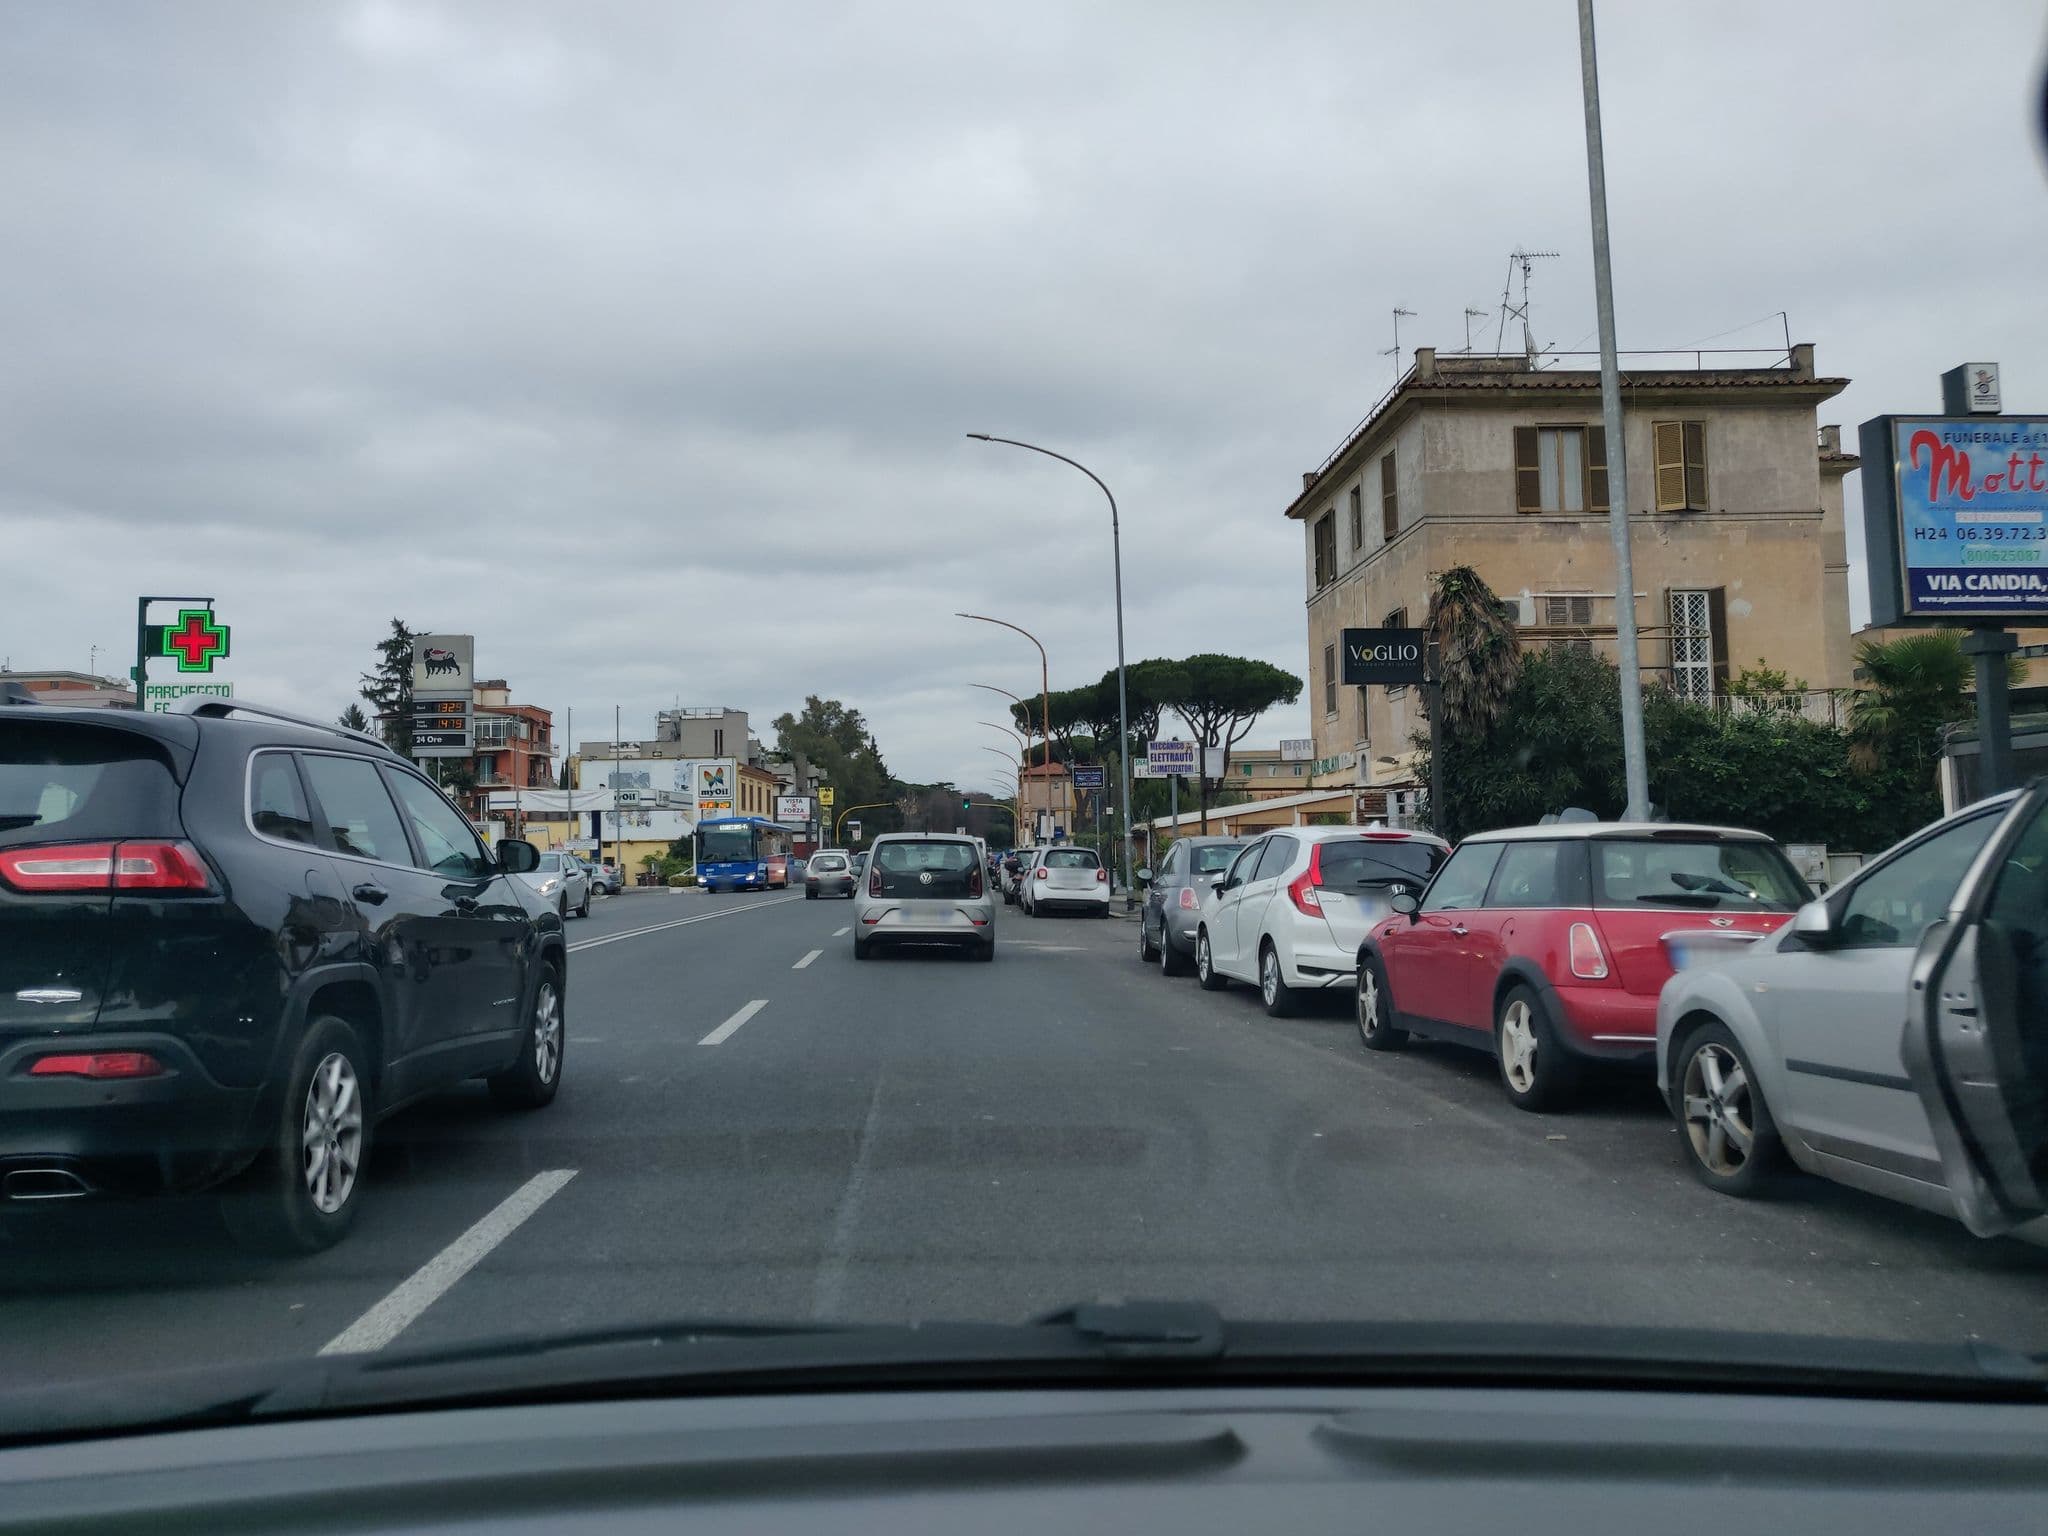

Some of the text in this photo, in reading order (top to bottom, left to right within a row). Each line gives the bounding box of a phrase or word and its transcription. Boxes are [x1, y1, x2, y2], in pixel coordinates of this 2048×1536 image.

[1944, 432, 2019, 443] FUNERALE
[1914, 527, 2048, 540] H24 06.39.72.3
[1926, 574, 1962, 591] VIA
[416, 736, 443, 744] 24 Ore
[1150, 742, 1184, 750] MECCANICO
[1283, 740, 1312, 752] BAR
[1150, 764, 1194, 773] CLIMATIZZATORI
[701, 788, 729, 797] myOil
